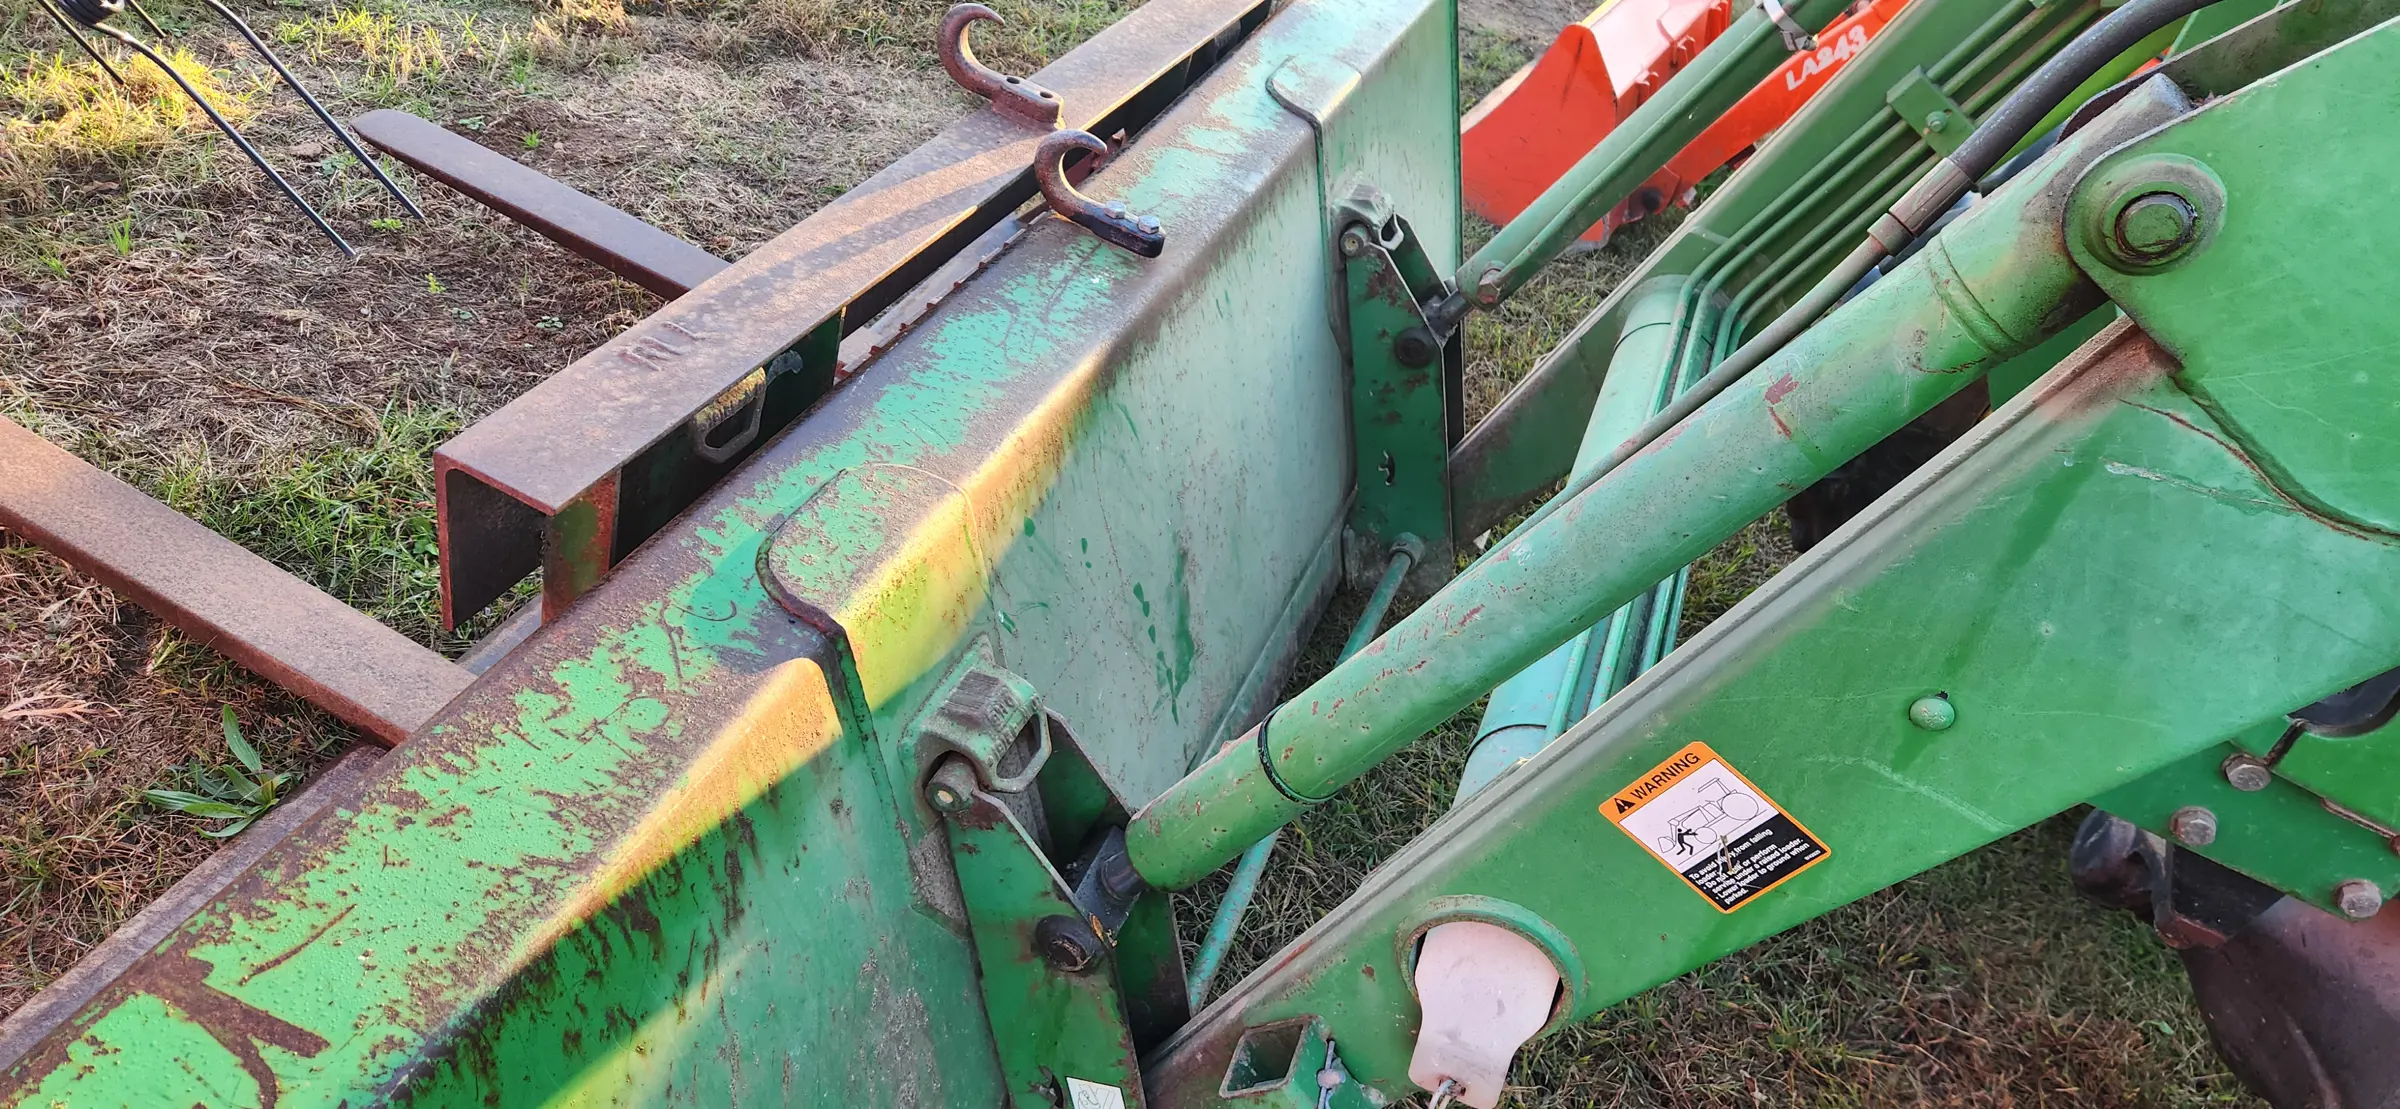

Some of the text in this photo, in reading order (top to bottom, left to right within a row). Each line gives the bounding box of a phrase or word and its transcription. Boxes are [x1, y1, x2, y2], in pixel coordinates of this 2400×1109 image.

[1785, 24, 1868, 91] LA243
[1630, 752, 1700, 800] WARNING
[1699, 861, 1717, 876] avoid
[1734, 842, 1751, 854] from
[1751, 829, 1773, 844] falling
[1706, 880, 1718, 888] Do
[1717, 874, 1728, 882] not
[1750, 844, 1777, 863] perform
[1712, 878, 1736, 894] service
[1736, 867, 1755, 880] under
[1760, 851, 1781, 866] raised
[1778, 838, 1803, 854] loader.
[1718, 885, 1739, 899] Lower
[1740, 873, 1760, 887] loader
[1768, 854, 1791, 872] ground
[1791, 842, 1809, 855] when
[1724, 889, 1749, 904] parked.
